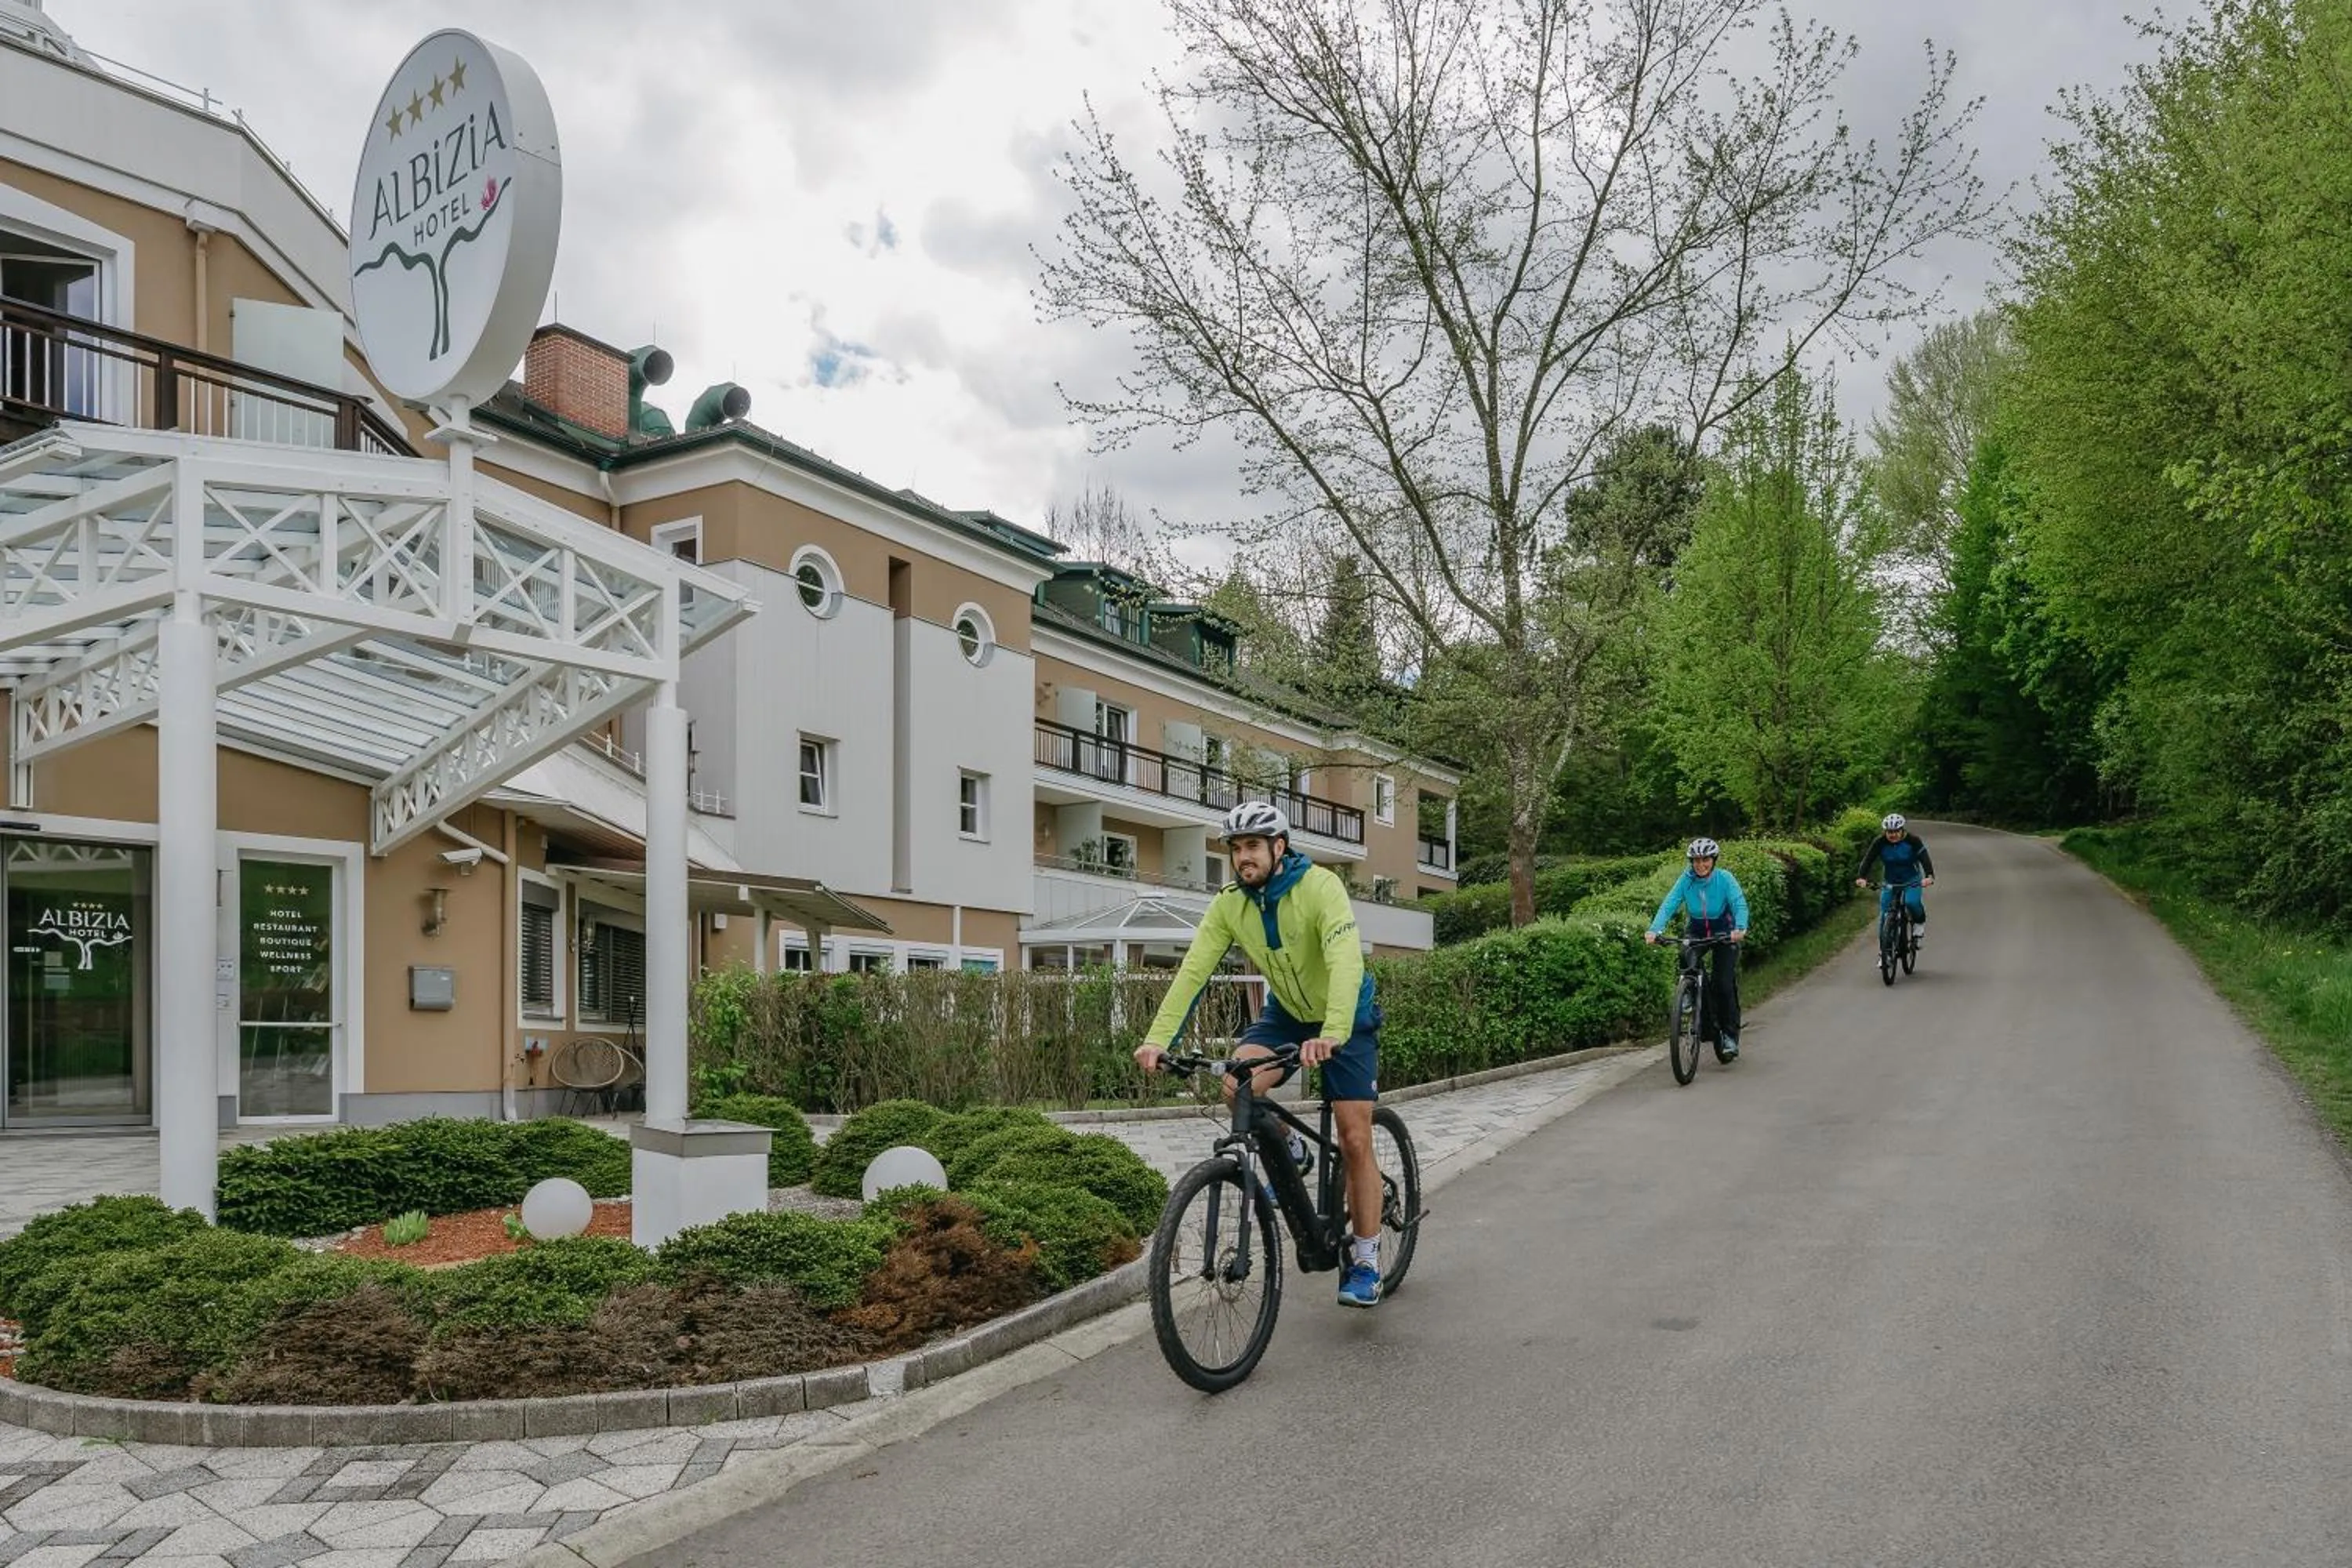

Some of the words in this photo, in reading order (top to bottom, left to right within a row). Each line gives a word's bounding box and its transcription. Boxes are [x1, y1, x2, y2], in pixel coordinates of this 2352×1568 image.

[413, 193, 470, 247] HOTEL
[68, 928, 107, 938] HOTEL
[253, 923, 318, 933] RESTAURANT
[260, 937, 312, 946] BOUTIQUE
[260, 951, 312, 960] WELLNESS
